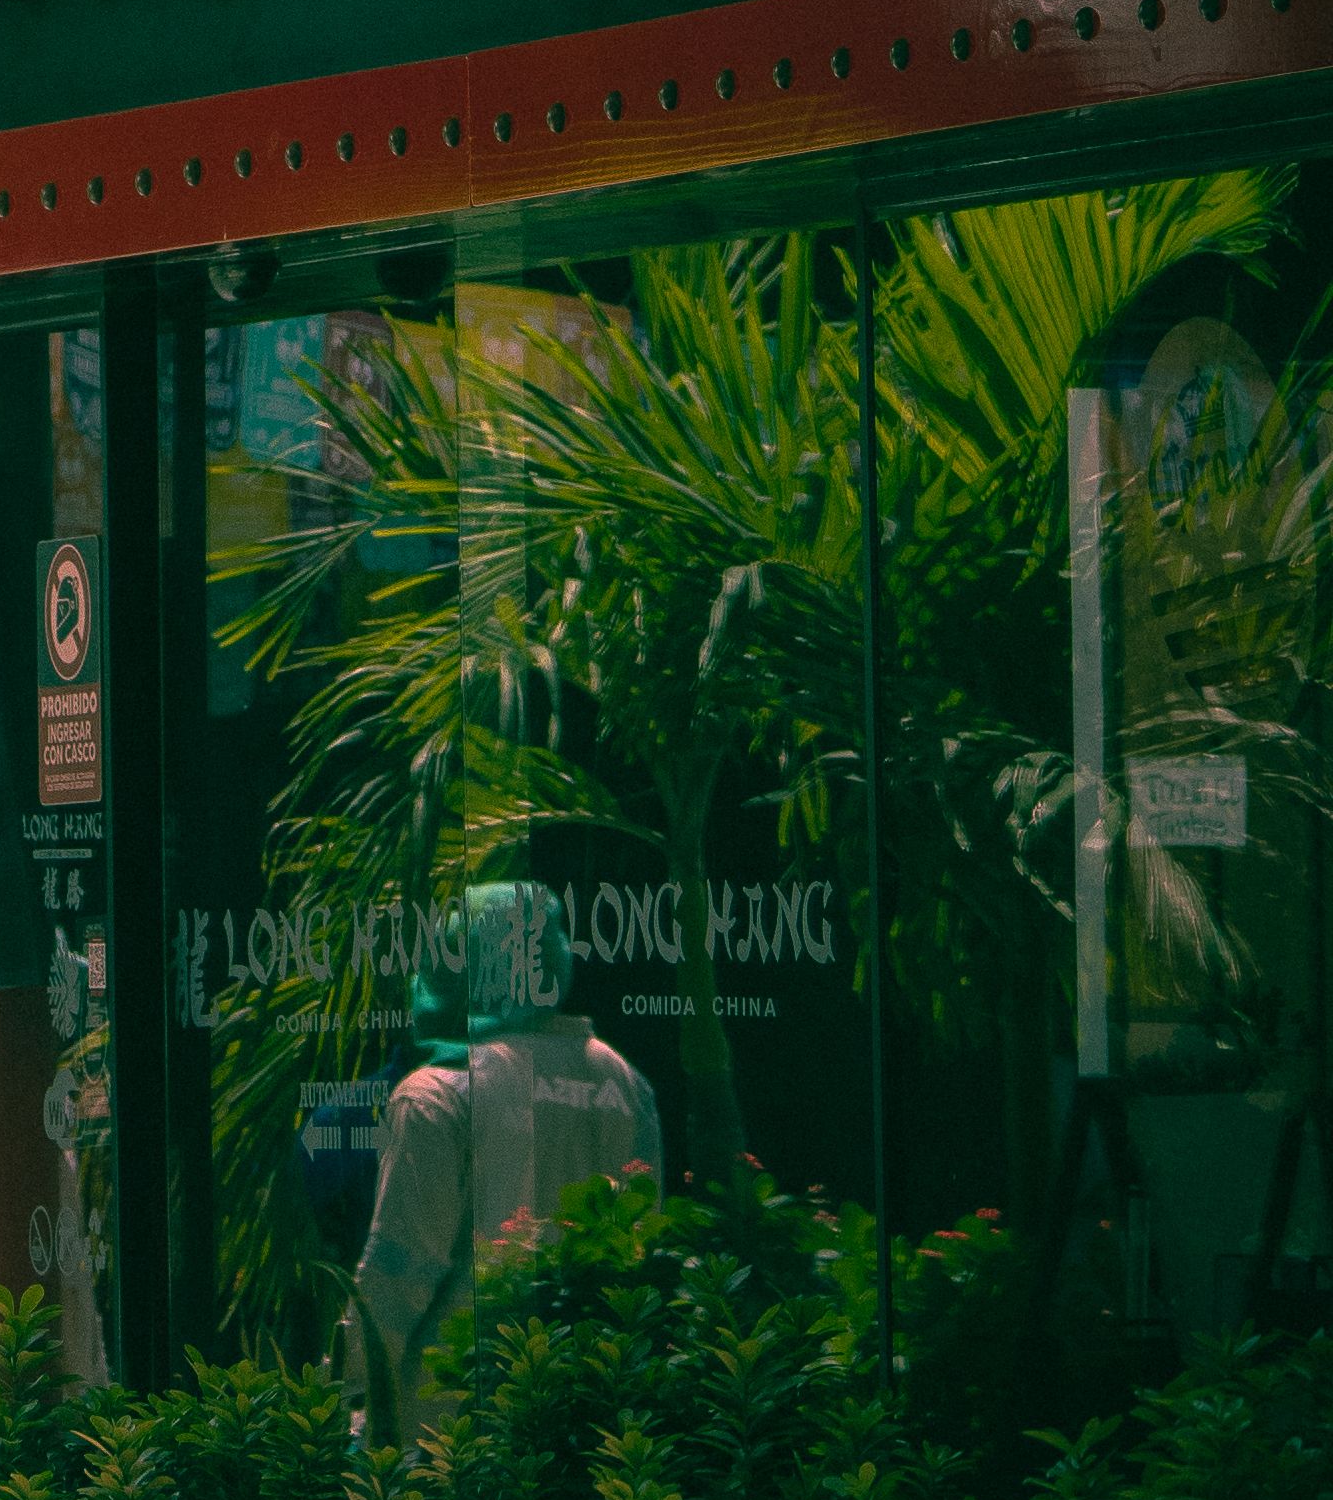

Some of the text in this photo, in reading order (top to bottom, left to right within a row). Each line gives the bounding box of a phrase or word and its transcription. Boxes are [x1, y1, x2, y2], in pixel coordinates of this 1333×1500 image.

[40, 691, 98, 718] PROHIBIDO
[46, 720, 92, 744] INGRESAR
[43, 742, 97, 766] CON CASCO
[22, 812, 103, 841] LONG HANG
[563, 879, 685, 965] LONG
[704, 878, 837, 965] HANG
[171, 906, 219, 1029] 龍
[222, 906, 334, 986] LONG
[350, 896, 467, 977] HANG
[620, 993, 778, 1018] COMIDA CHINA
[274, 1009, 416, 1034] COMIDA CHINA
[298, 1080, 390, 1108] AUTOMATICA
